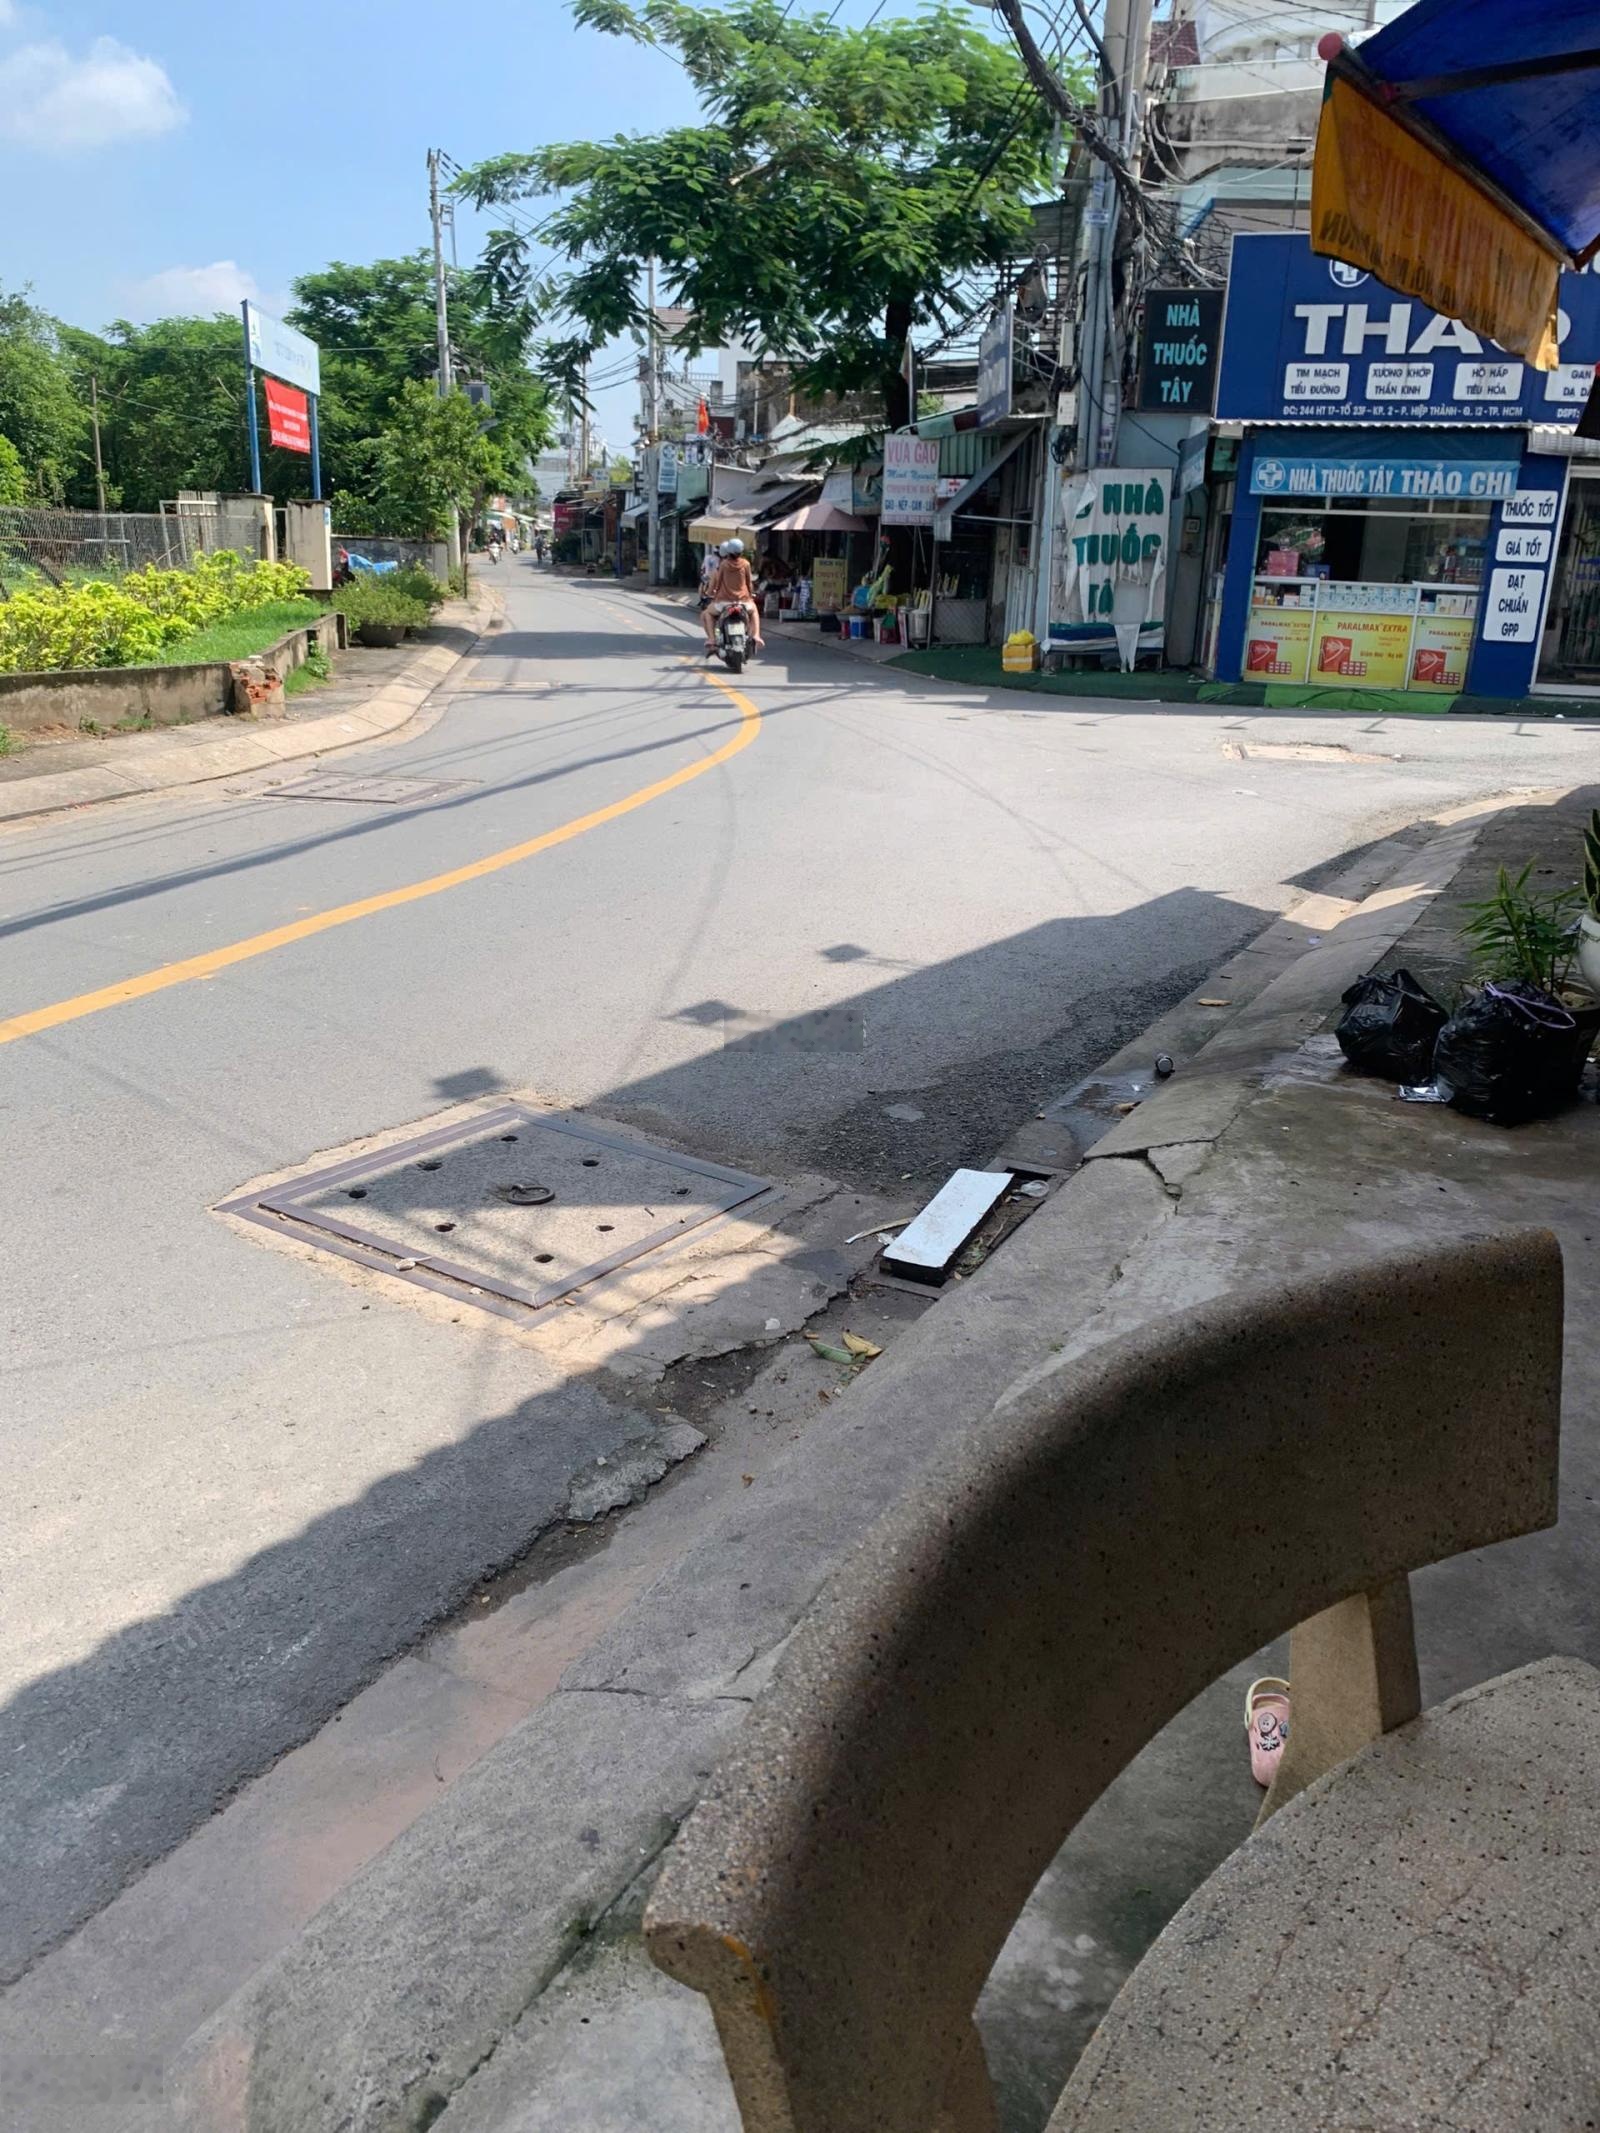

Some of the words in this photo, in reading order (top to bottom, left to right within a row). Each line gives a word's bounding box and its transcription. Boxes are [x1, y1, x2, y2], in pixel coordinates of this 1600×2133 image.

[1166, 298, 1200, 327] NHÀ
[1153, 334, 1207, 366] THUỐC
[1296, 368, 1310, 378] TIM
[1314, 368, 1340, 379] MẠCH
[1406, 366, 1432, 378] KHỚP
[1472, 366, 1486, 378] HÔ
[1489, 364, 1508, 378] HẤP
[1571, 369, 1592, 380] GAN
[1161, 376, 1192, 402] TÂY
[1310, 383, 1341, 395] ĐƯỜNG
[1401, 385, 1421, 395] KINH
[1487, 383, 1507, 395] HÓA
[1300, 405, 1314, 416] 244
[1502, 406, 1523, 416] HCM
[1289, 463, 1317, 491] NHÀ
[1321, 462, 1365, 493] THUỐC
[1368, 465, 1395, 493] TÂY
[1400, 463, 1462, 495] THẢO
[1470, 470, 1513, 496] CHI
[1103, 477, 1165, 515] NHÀ
[1504, 496, 1534, 517] THUỐC
[1537, 495, 1554, 517] TỐT
[1505, 537, 1522, 556] GIÁ
[1526, 536, 1542, 557] TỐT
[1507, 574, 1525, 593] ĐẠT
[1498, 592, 1528, 614] CHUẨN
[1337, 621, 1380, 632] PARALMAX
[1382, 622, 1408, 634] EXTRA
[1501, 622, 1519, 638] GPP
